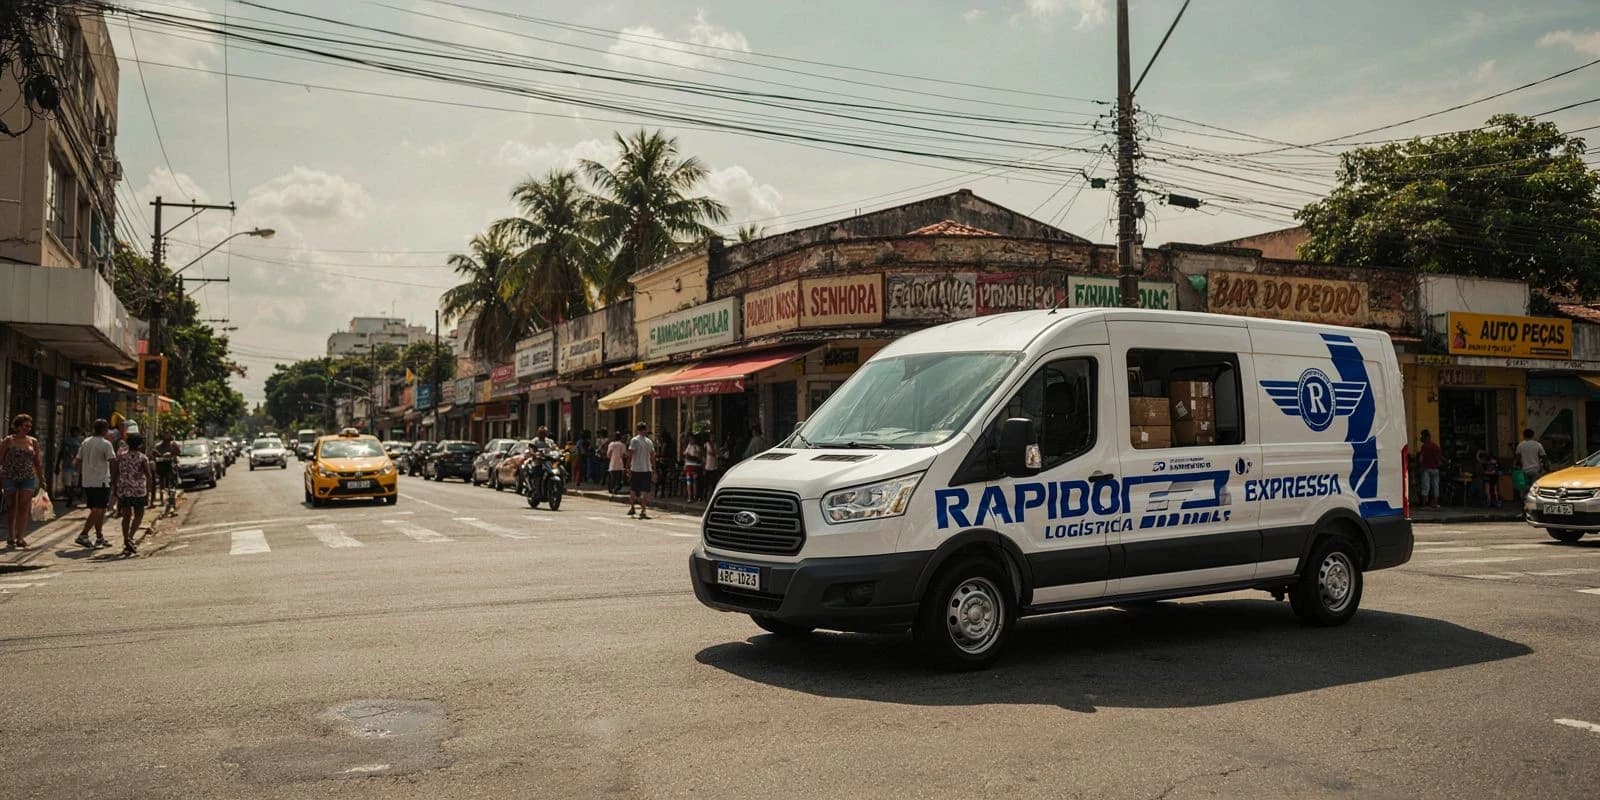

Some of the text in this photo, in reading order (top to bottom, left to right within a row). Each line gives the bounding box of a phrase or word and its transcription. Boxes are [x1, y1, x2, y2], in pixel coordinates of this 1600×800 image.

[811, 283, 877, 317] SENHORA
[1214, 275, 1362, 316] BAR DO PEDRO
[692, 308, 729, 337] POPULAR
[1480, 320, 1565, 346] AUTO PEÇAS
[1306, 382, 1327, 413] R
[1245, 473, 1342, 502] EXPRESSA
[1045, 517, 1133, 539] LOGÍSTICA
